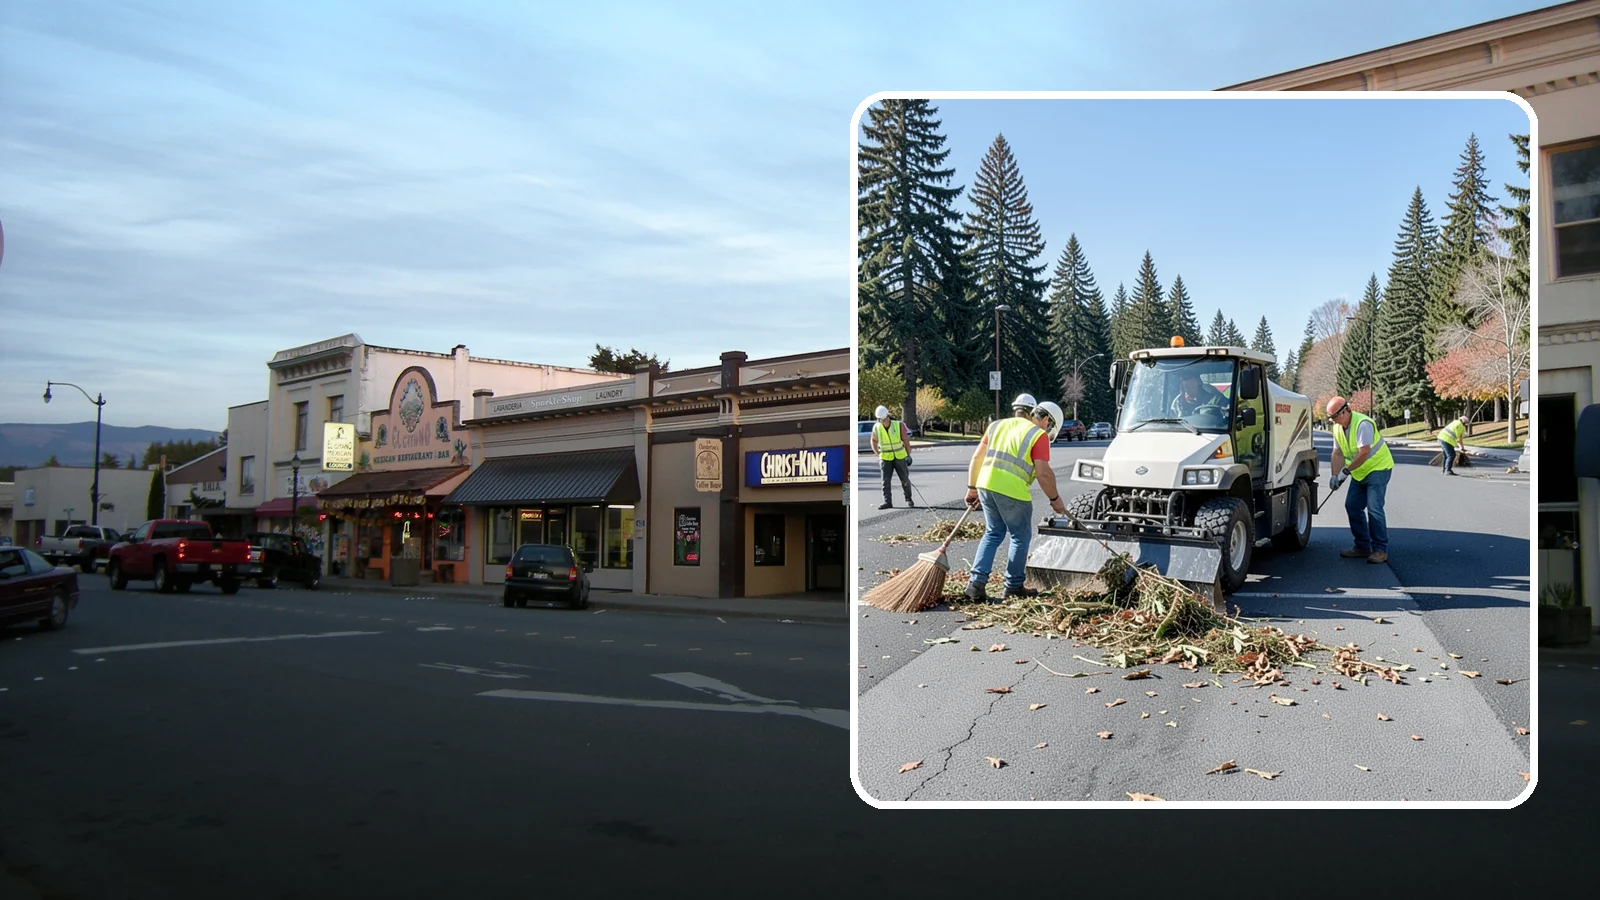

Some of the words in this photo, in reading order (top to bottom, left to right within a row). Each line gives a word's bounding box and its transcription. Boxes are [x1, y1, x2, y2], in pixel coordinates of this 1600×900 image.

[595, 389, 624, 400] LAUNDRY
[493, 402, 523, 413] LAVANDERIA
[530, 397, 561, 410] Sparkle
[561, 394, 582, 405] Shop
[373, 455, 396, 464] MEXICAN
[397, 451, 434, 462] RESTAURANT
[438, 450, 450, 459] BAR
[761, 452, 798, 478] CHRIST
[799, 450, 828, 476] KING
